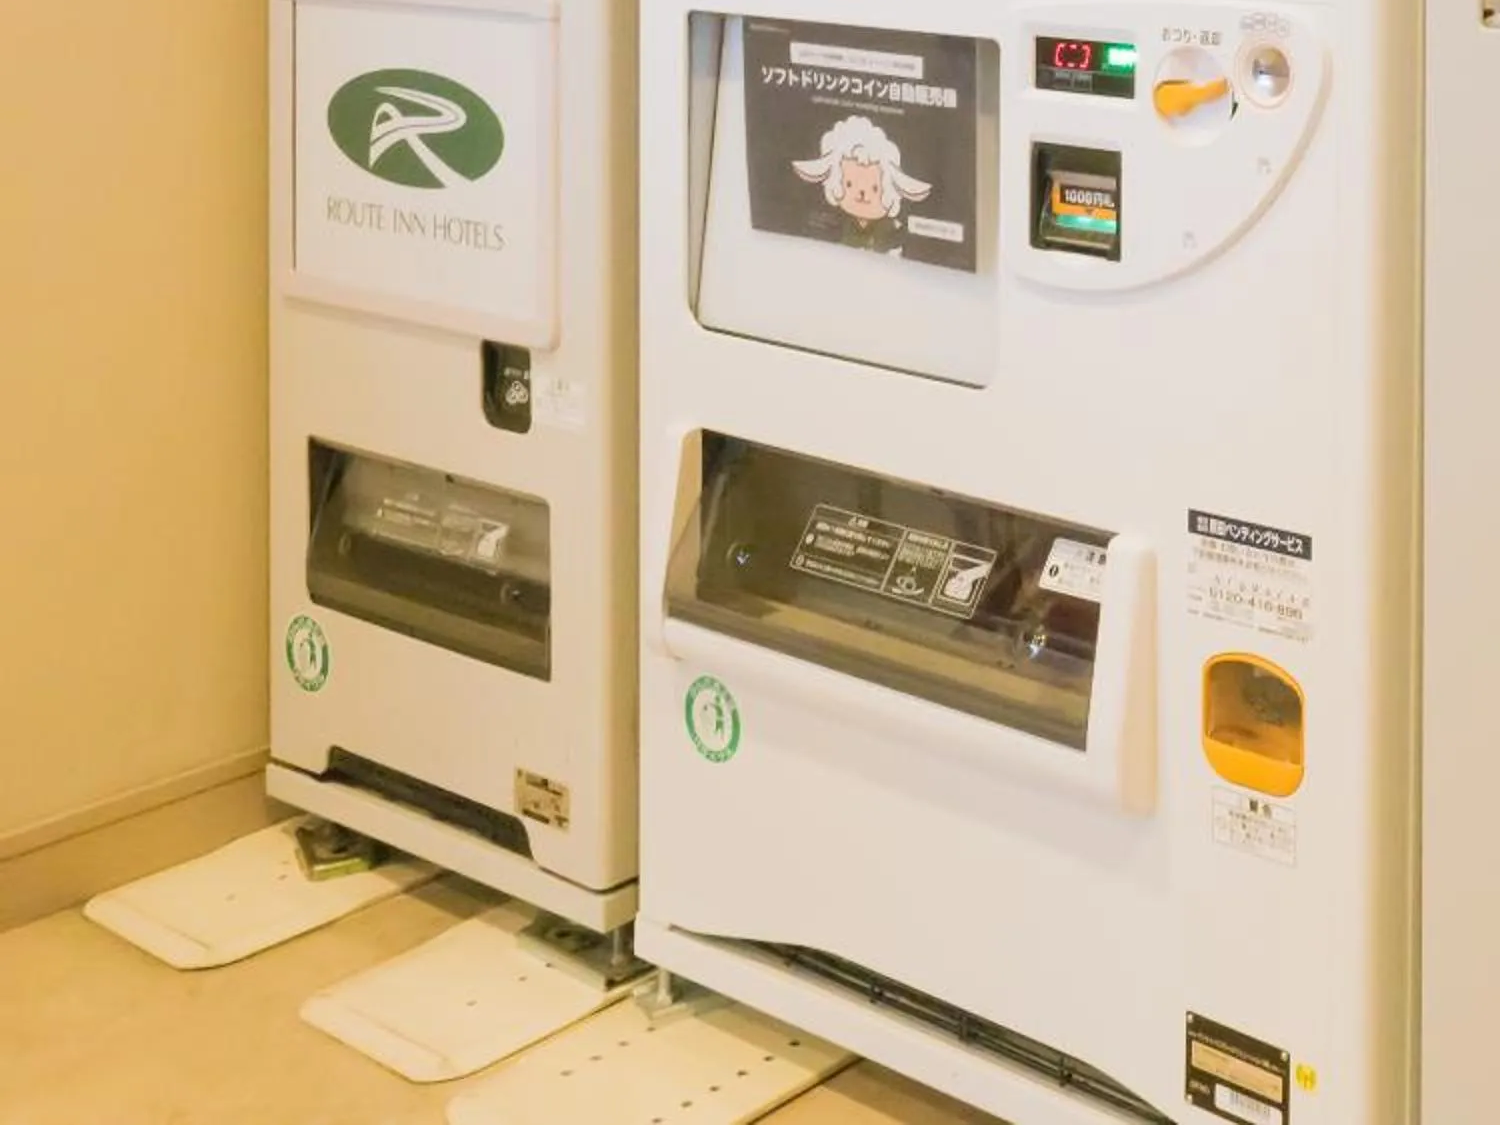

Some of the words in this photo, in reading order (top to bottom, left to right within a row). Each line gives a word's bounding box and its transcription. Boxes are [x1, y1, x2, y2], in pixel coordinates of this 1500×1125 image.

[761, 66, 957, 110] ソフトドリンクコイン自動販売機
[327, 196, 386, 232] ROUTE
[393, 209, 427, 238] INN
[432, 213, 506, 253] HOTELS
